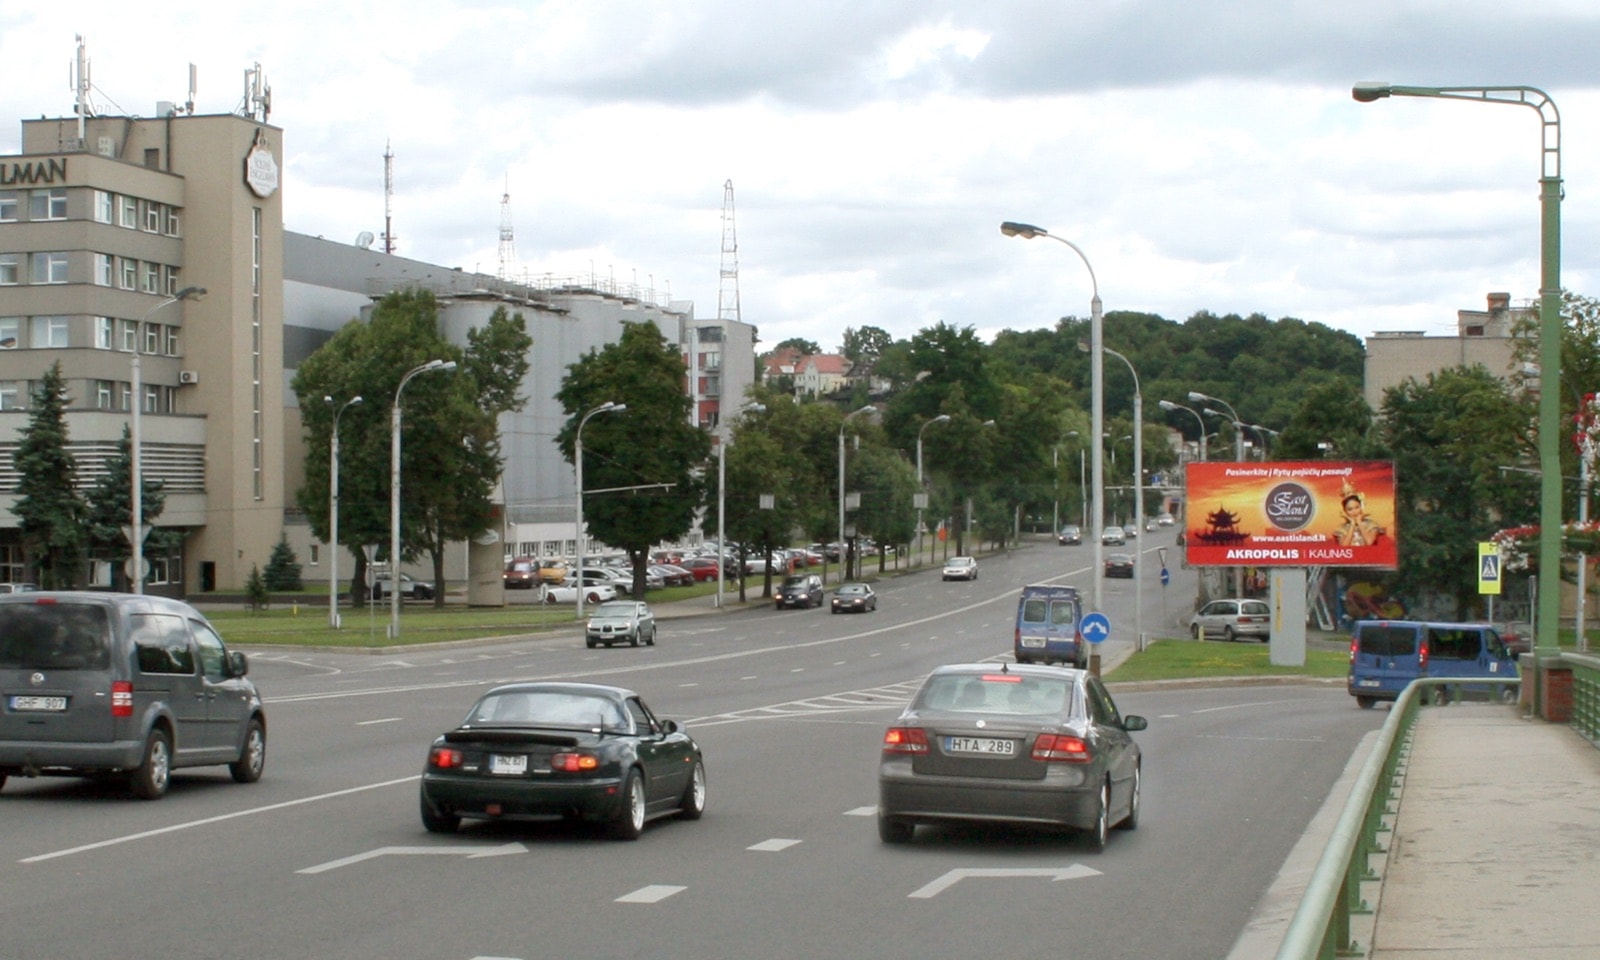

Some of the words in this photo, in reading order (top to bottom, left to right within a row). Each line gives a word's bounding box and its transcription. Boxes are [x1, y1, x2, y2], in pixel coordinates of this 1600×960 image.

[1225, 468, 1269, 476] Pasinerkite
[1272, 469, 1291, 477] Rytų
[1274, 491, 1307, 505] East
[1252, 534, 1326, 542] www.eastisland.lt
[1226, 549, 1299, 559] AKROPOLIS
[1308, 548, 1353, 558] KAUNAS
[45, 698, 65, 709] 907
[952, 738, 979, 751] HTA
[988, 740, 1012, 753] 289
